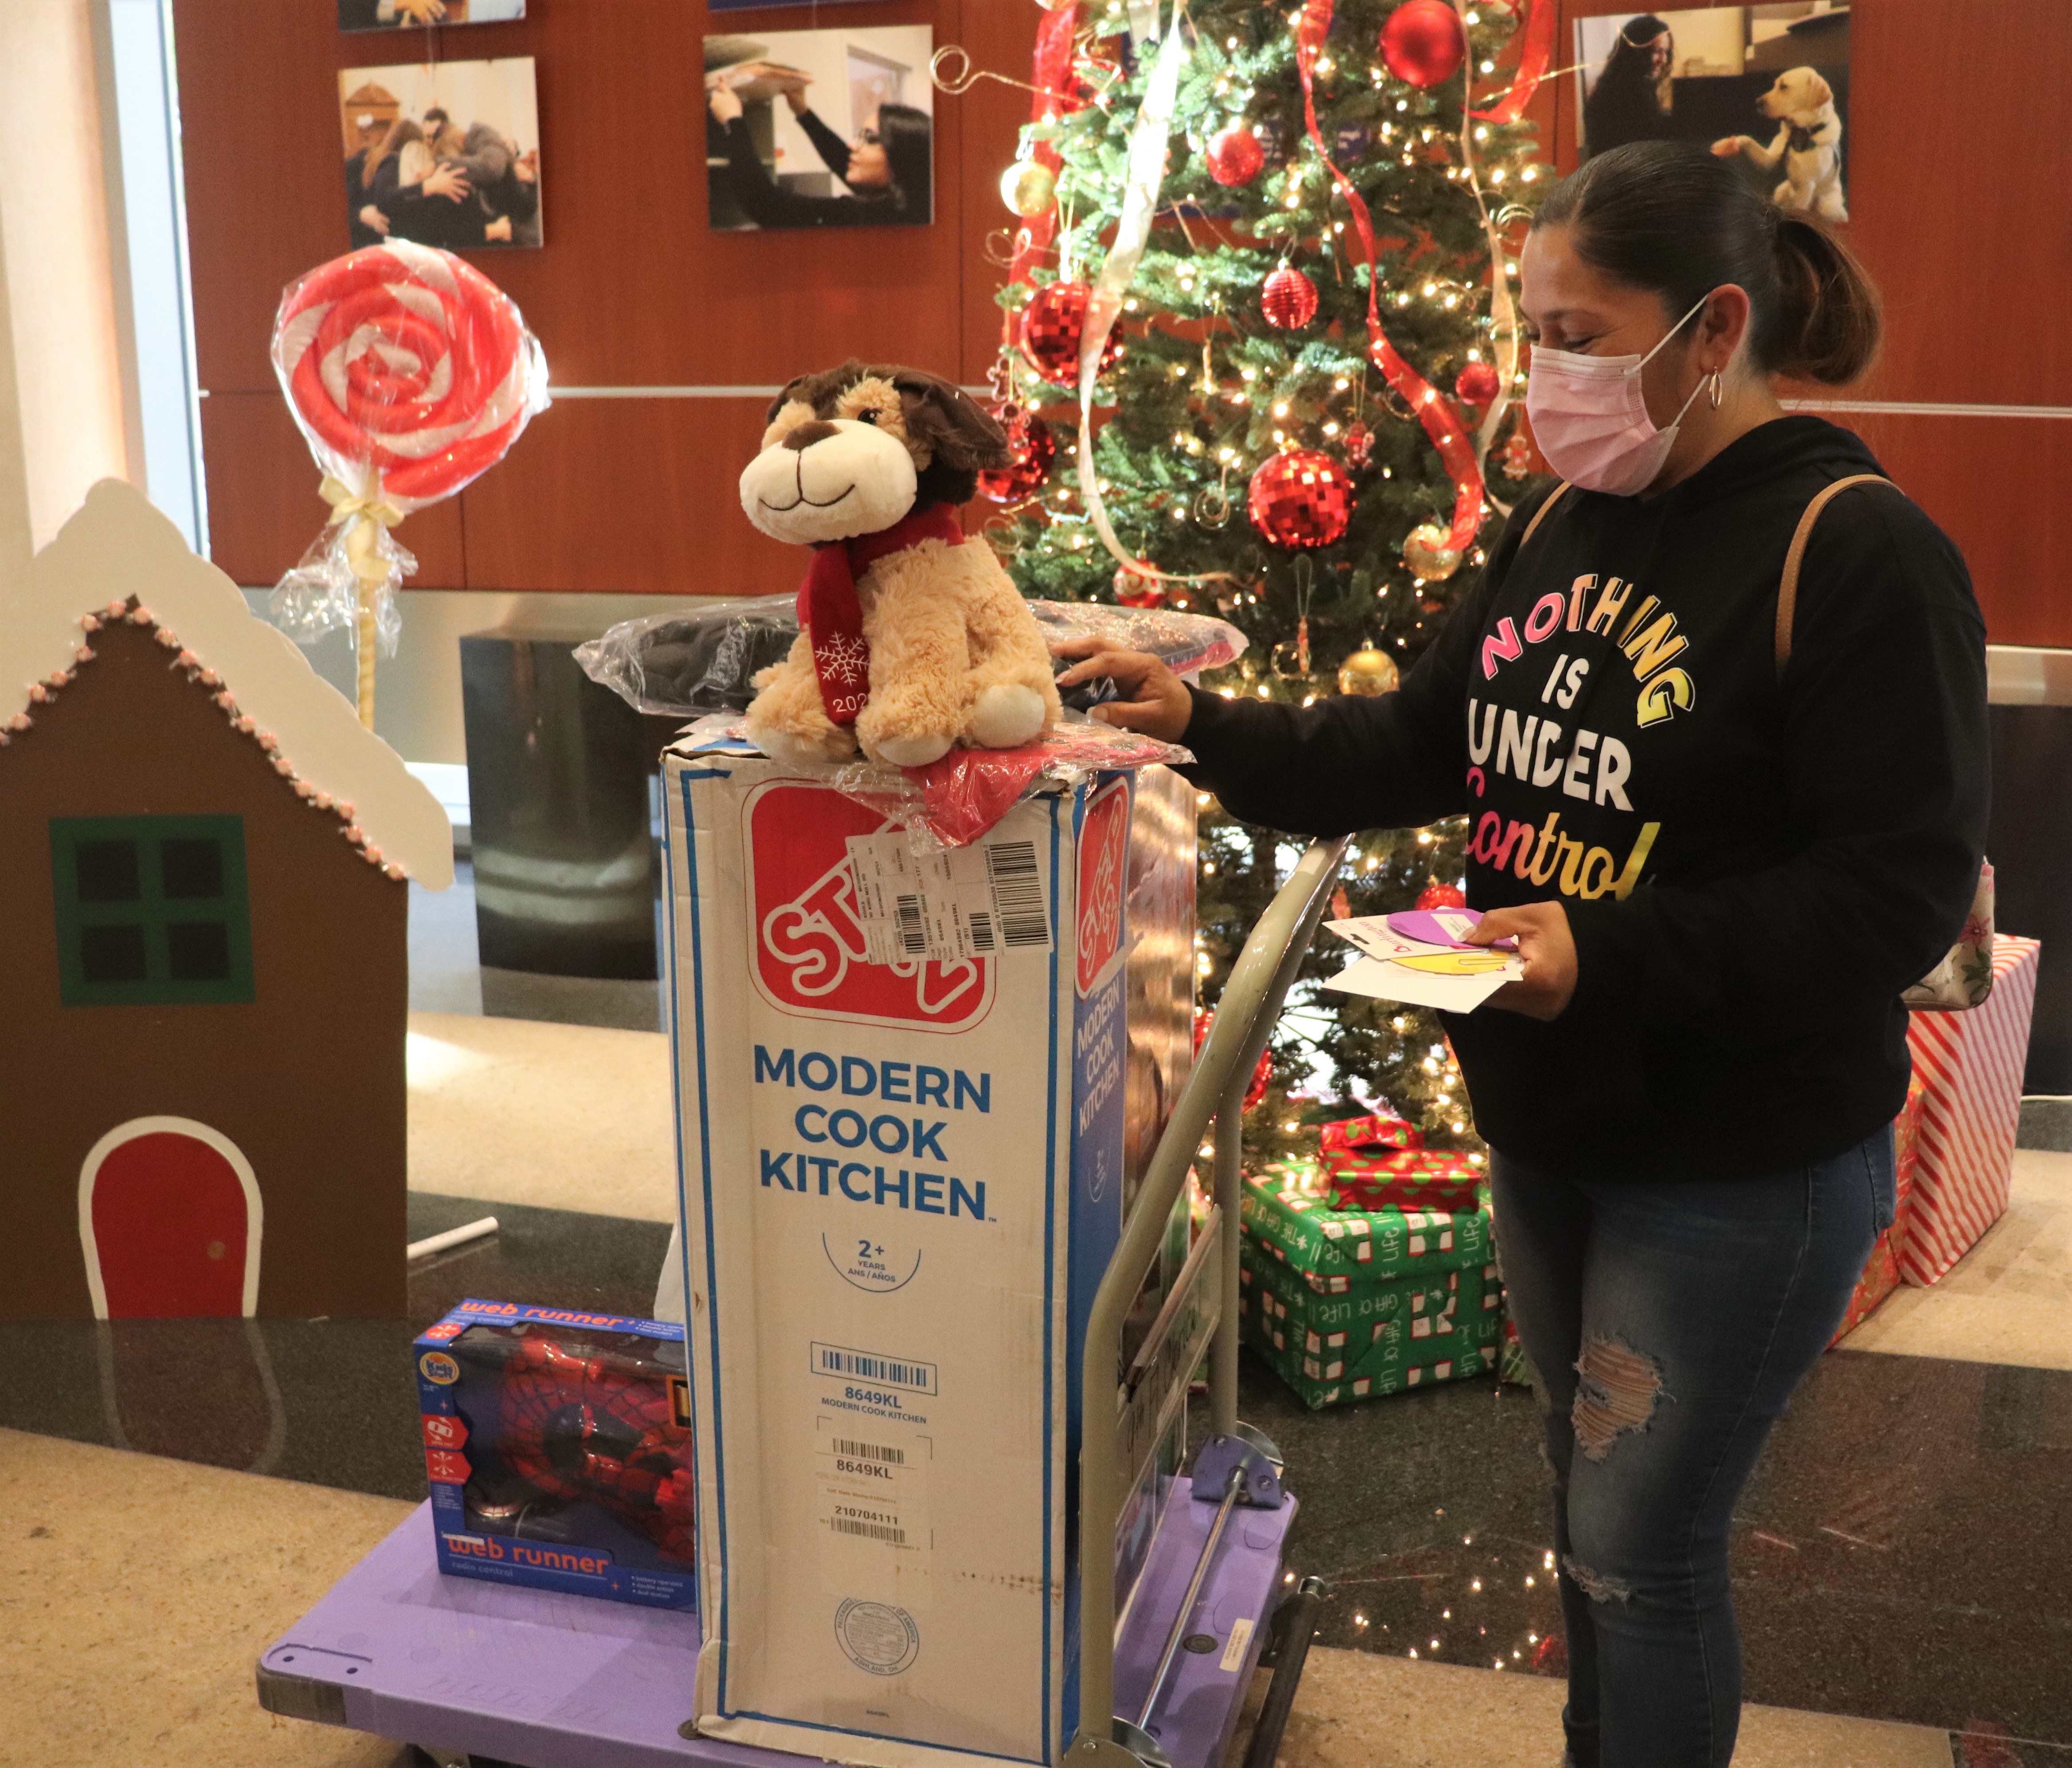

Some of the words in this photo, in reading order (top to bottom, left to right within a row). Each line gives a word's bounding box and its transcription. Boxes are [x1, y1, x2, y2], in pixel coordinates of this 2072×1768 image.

[1482, 573, 1696, 729] NOTHING
[1541, 654, 1589, 709] IS
[833, 693, 868, 712] 202
[1469, 698, 1634, 811] UNDER
[1077, 976, 1120, 1059] MODERN
[1087, 1022, 1114, 1085] COOK
[754, 1045, 991, 1113] MODERN
[1079, 1053, 1120, 1138] KITCHEN
[795, 1104, 948, 1162] COOK
[760, 1149, 985, 1221] KITCHEN
[858, 1239, 885, 1258] 2+
[847, 1267, 866, 1278] ANS
[872, 1270, 896, 1283] AÑOS
[858, 1260, 885, 1271] YEARS
[460, 1301, 519, 1316] web
[524, 1309, 624, 1326] runner
[821, 1397, 859, 1411] MODERN
[861, 1405, 887, 1418] COOK
[888, 1410, 927, 1424] KITCHEN
[845, 1387, 902, 1409] 8649KL
[837, 1459, 893, 1479] 8649KL
[835, 1505, 898, 1525] 210704111
[452, 1560, 476, 1571] radio
[478, 1565, 513, 1578] control
[513, 1546, 609, 1575] runner
